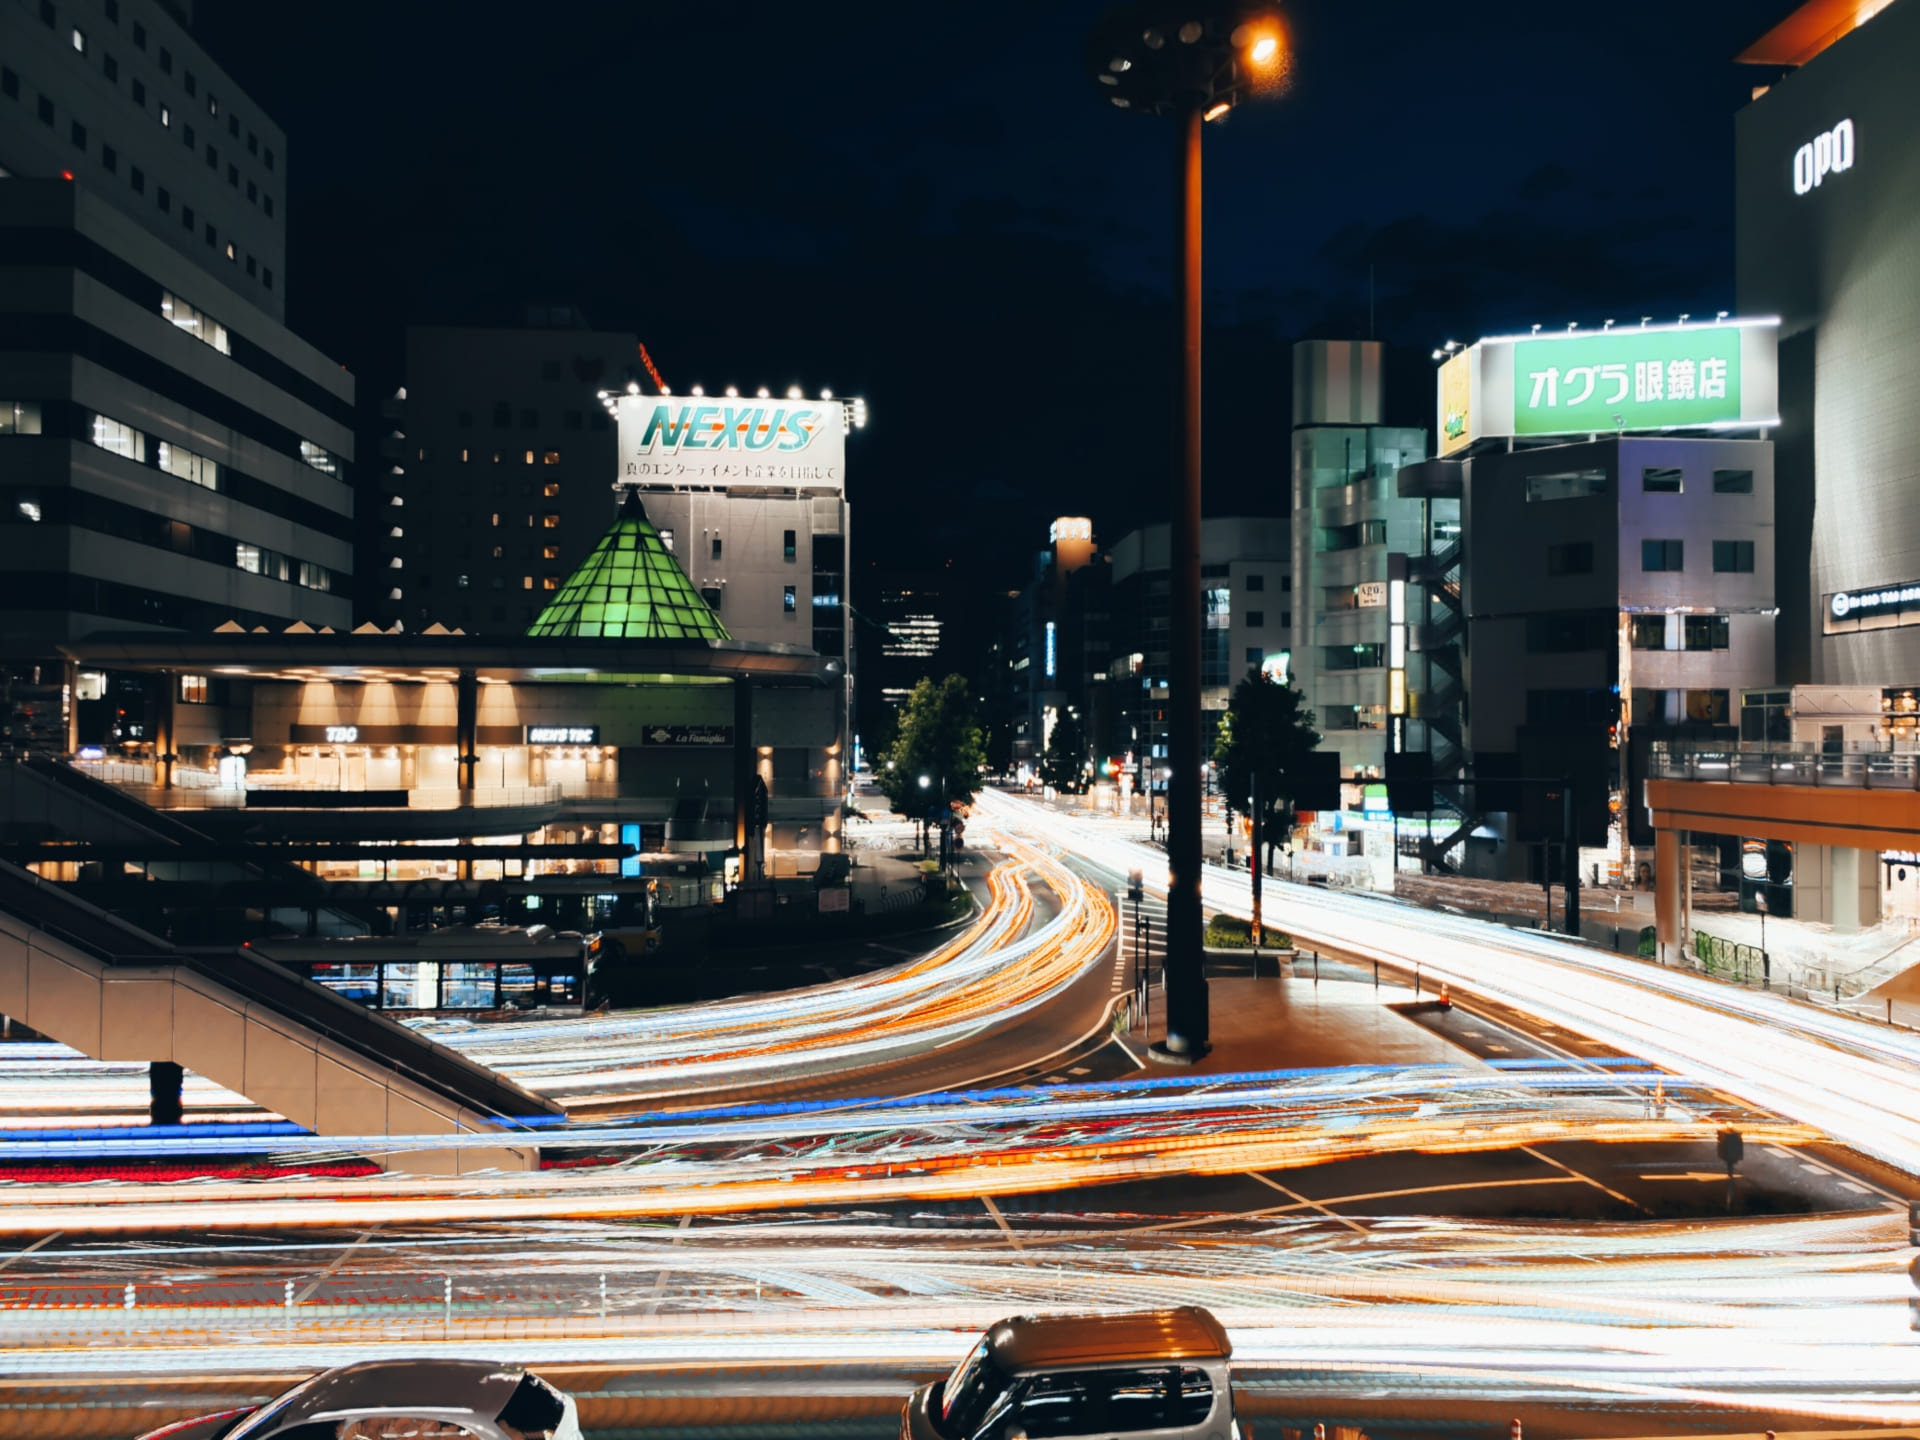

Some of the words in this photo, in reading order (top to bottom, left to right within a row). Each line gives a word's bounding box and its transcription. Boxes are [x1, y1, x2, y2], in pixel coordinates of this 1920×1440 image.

[1529, 357, 1728, 408] オグラ眼鏡店
[639, 404, 820, 455] NEXUS
